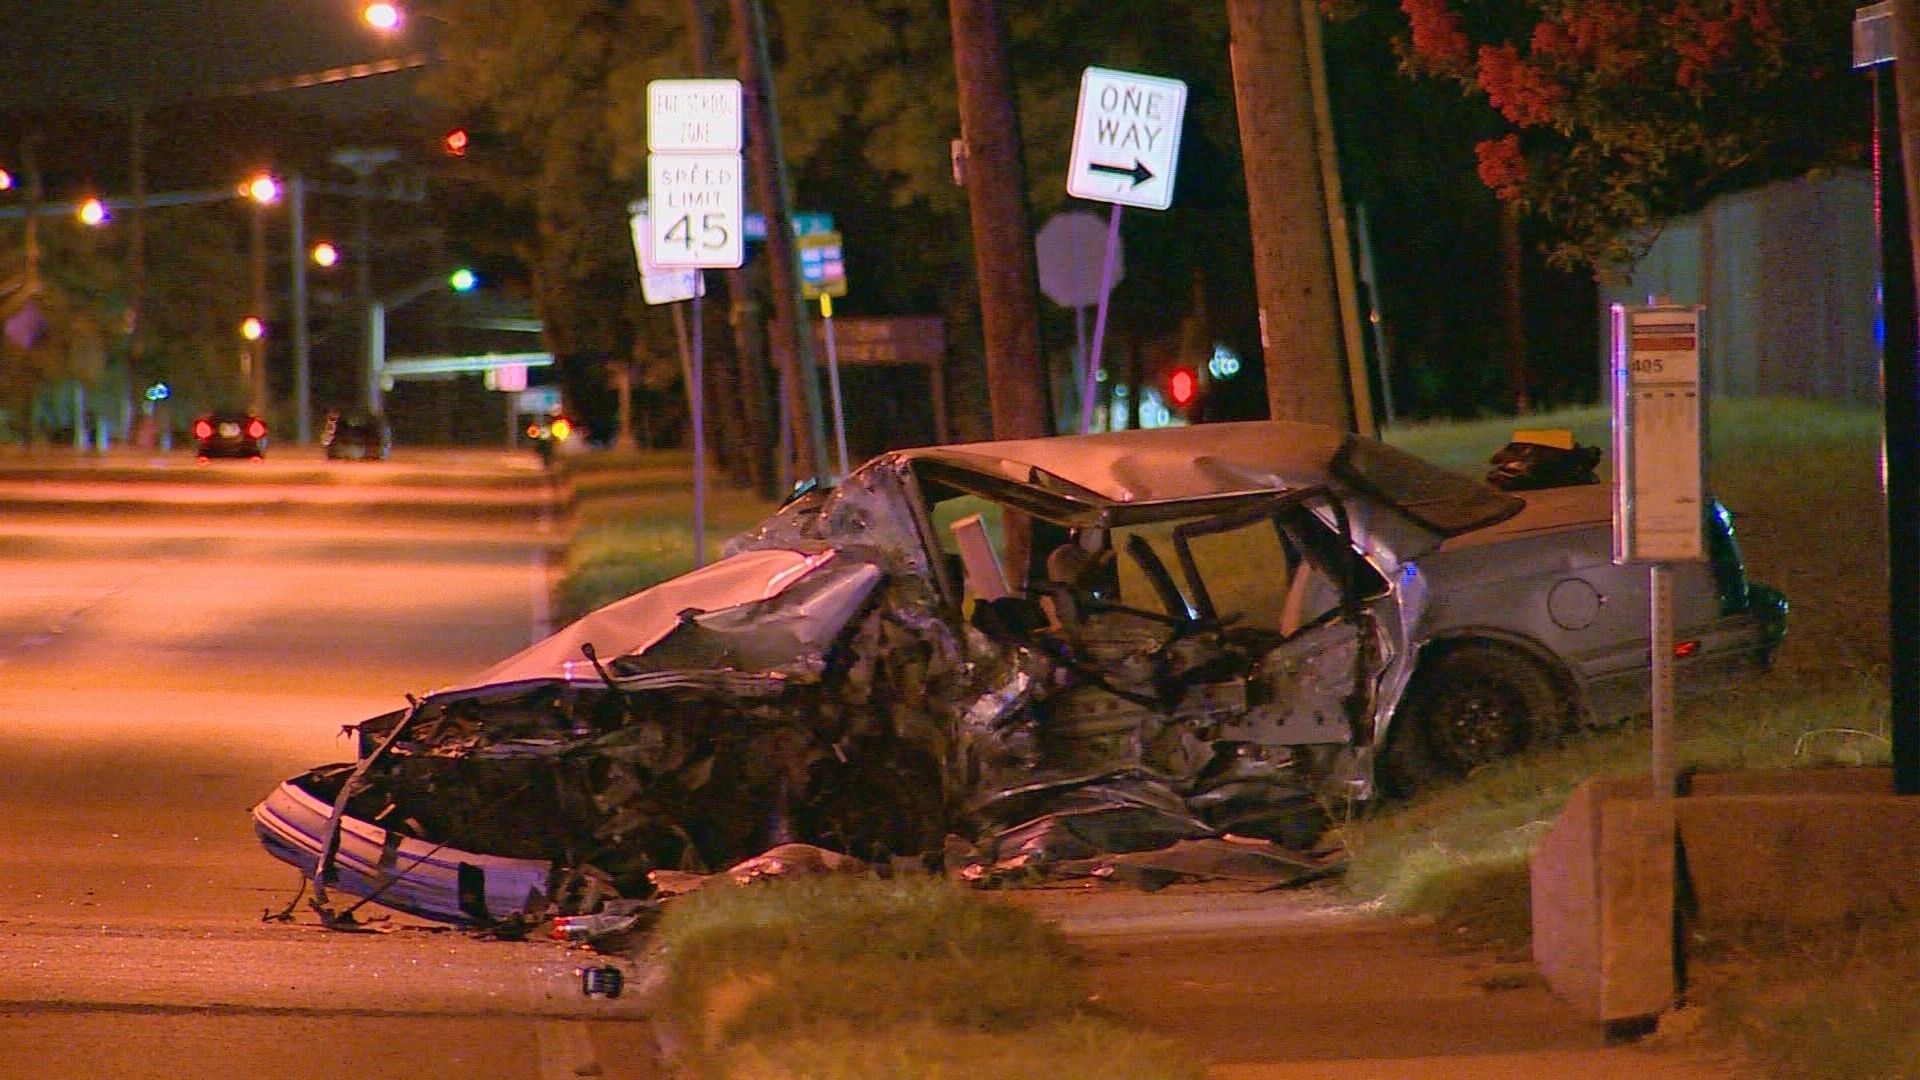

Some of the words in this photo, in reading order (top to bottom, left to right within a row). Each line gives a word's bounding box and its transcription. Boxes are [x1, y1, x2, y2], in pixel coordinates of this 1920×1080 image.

[1101, 85, 1164, 120] ONE
[1097, 118, 1162, 152] WAY
[661, 168, 732, 185] SPEED
[667, 191, 722, 208] LIMIT
[663, 211, 730, 250] 45
